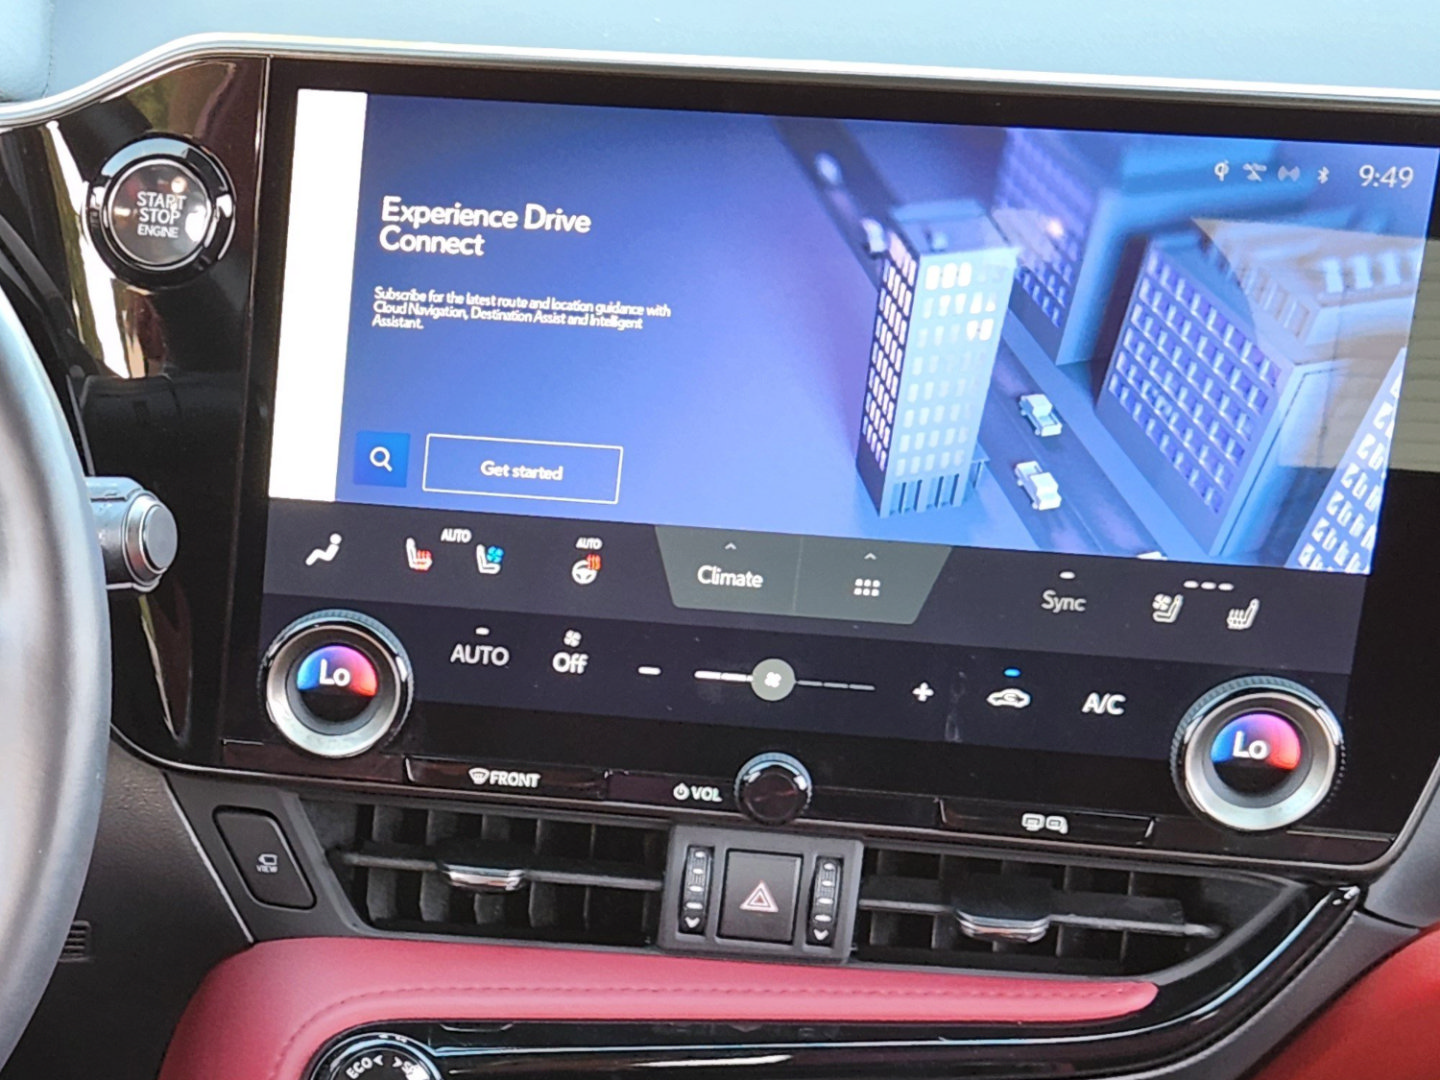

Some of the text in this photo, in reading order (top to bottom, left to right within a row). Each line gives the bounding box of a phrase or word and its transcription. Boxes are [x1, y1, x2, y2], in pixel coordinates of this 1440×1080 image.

[1359, 164, 1414, 188] 9:49
[137, 191, 187, 210] START
[139, 207, 181, 225] STOP
[381, 195, 591, 233] Experience Drive
[137, 224, 179, 238] ENGINE
[379, 225, 485, 256] Connect
[374, 286, 671, 318] Subscribe for the latest route and location guidance with
[373, 300, 643, 331] Cloud Navigation, Destination Assist and Intelligent
[480, 461, 563, 481] Get started
[441, 528, 472, 544] AUTO
[576, 537, 602, 551] AUTO
[697, 565, 763, 588] Climate
[1041, 590, 1086, 612] Sync
[450, 644, 509, 666] AUTO
[552, 651, 589, 676] Off
[318, 660, 351, 686] Lo
[1082, 693, 1125, 714] A/C
[1233, 729, 1269, 760] Lo
[488, 771, 541, 789] FRONT
[691, 786, 723, 802] VOL
[345, 1056, 374, 1080] ECO
